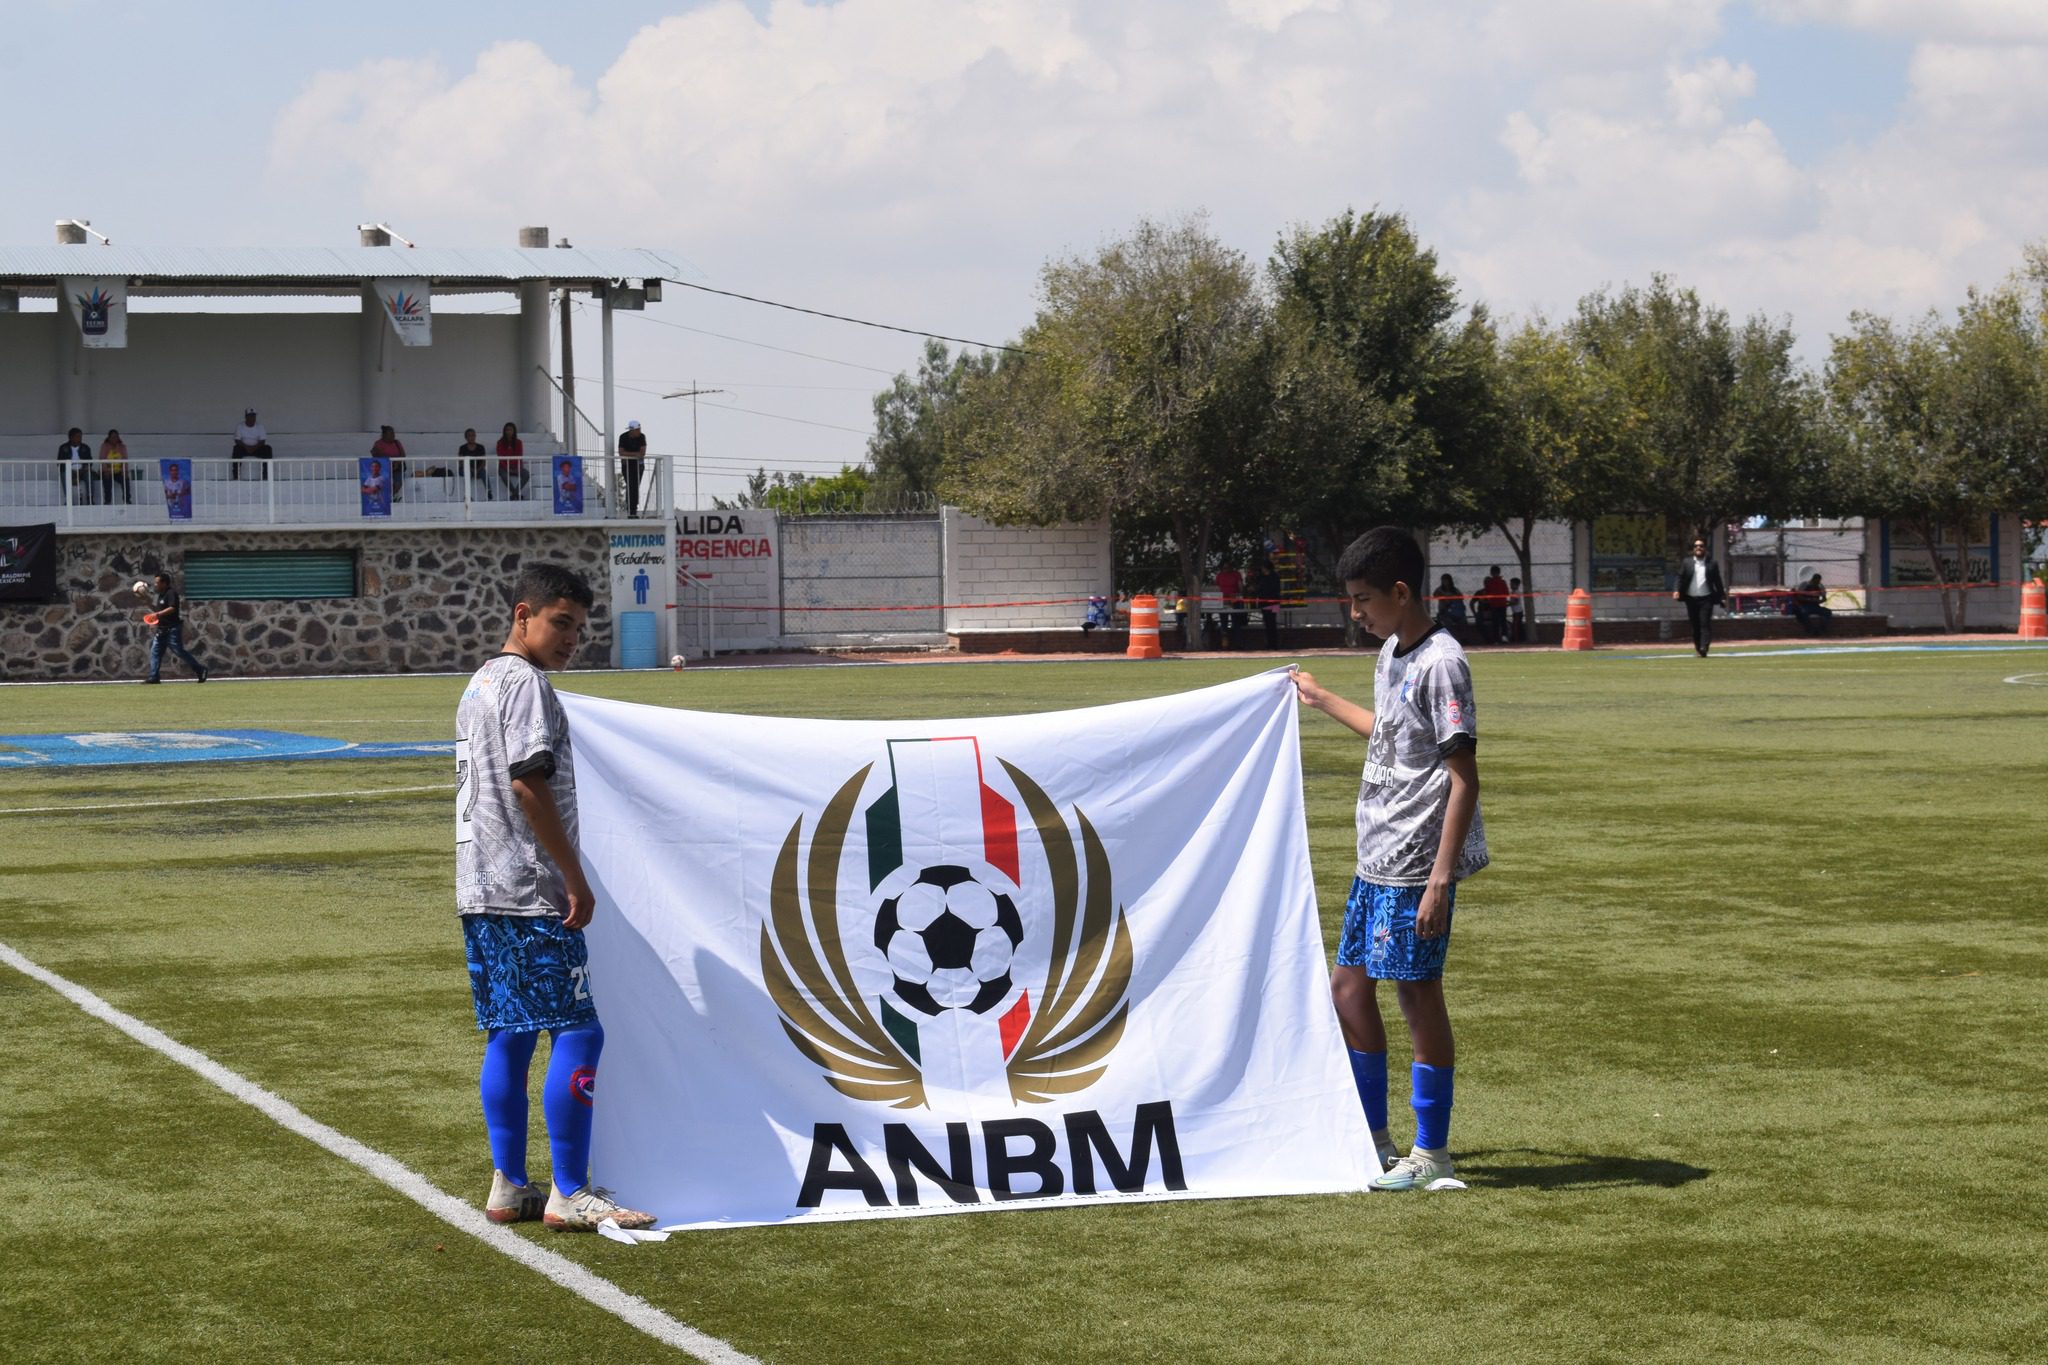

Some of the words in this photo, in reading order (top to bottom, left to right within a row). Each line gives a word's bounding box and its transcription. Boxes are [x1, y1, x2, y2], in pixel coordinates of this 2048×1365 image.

[609, 534, 666, 548] SANITARIO
[676, 538, 773, 559] RGENCIA
[796, 1100, 1188, 1208] ANBM
